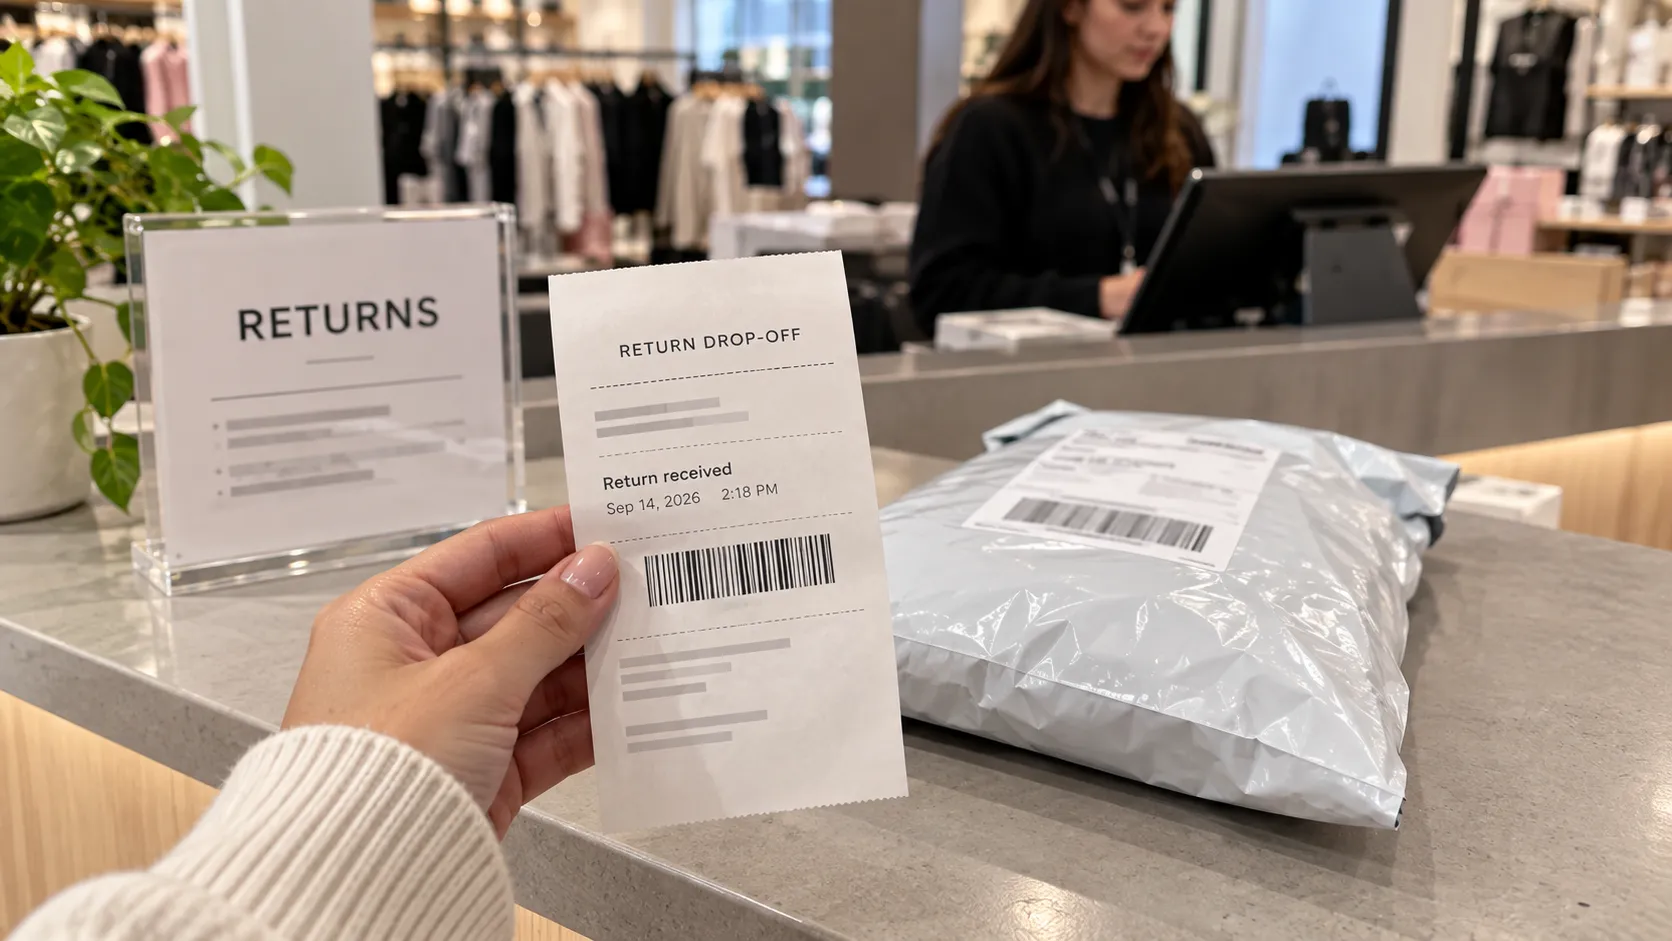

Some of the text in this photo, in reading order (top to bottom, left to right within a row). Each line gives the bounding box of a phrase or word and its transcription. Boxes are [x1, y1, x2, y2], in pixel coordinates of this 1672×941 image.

[238, 296, 440, 342] RETURNS
[619, 328, 801, 358] RETURN DROP-OFF
[603, 462, 733, 491] Return received
[606, 483, 779, 516] Sep 14, 2026 2:18 PM
